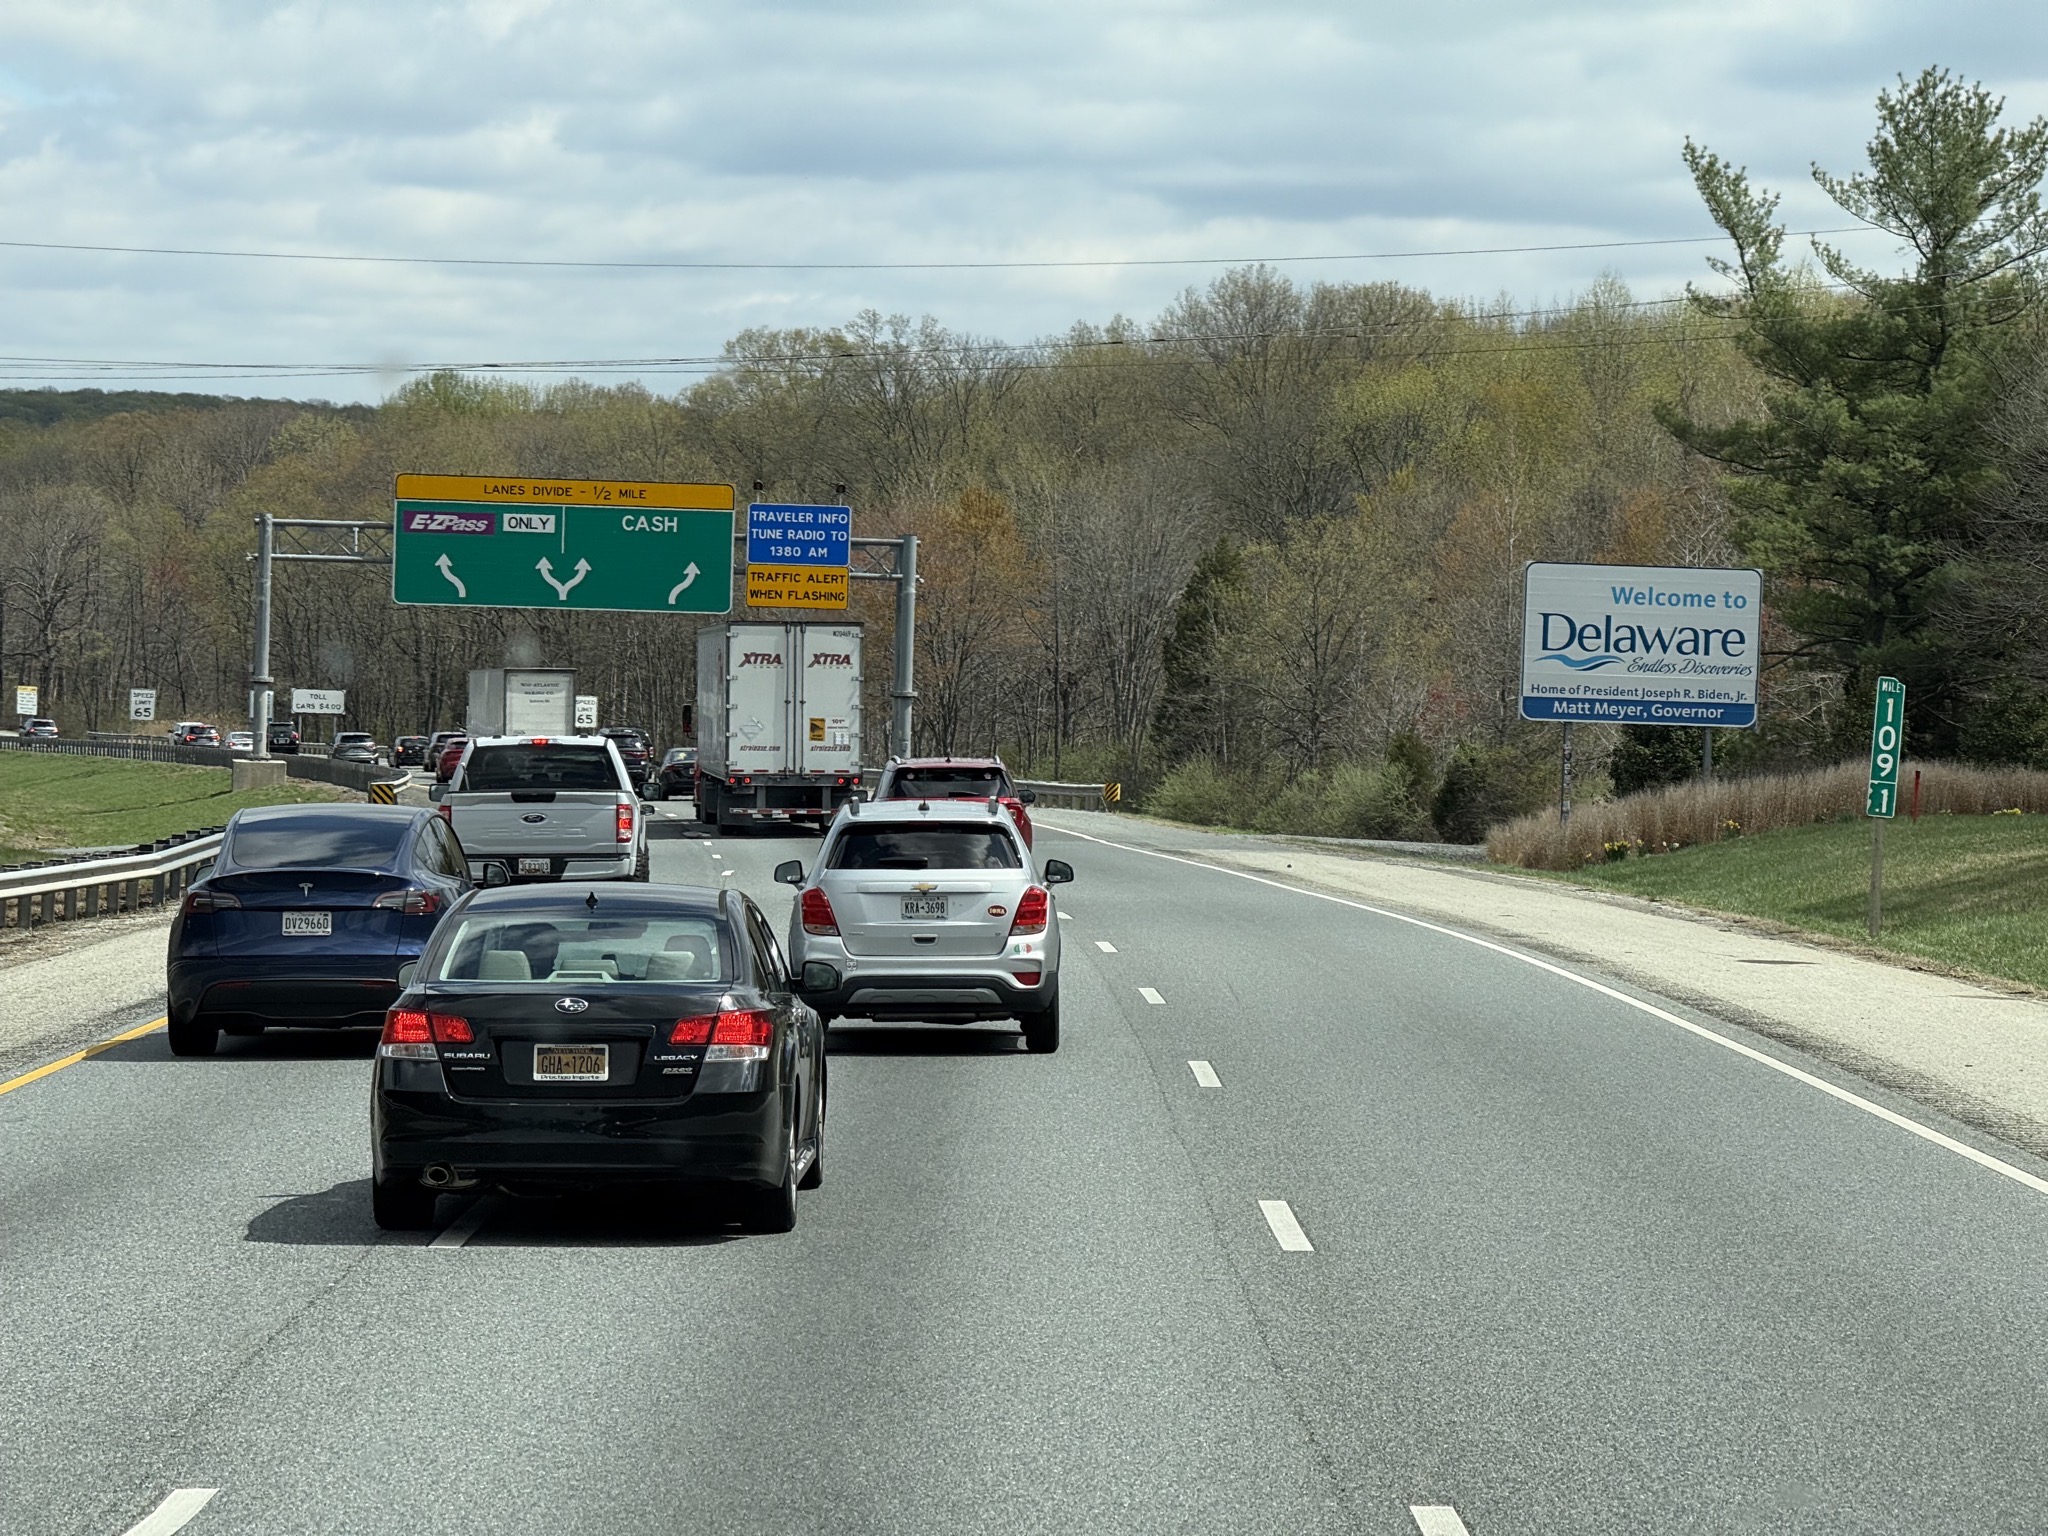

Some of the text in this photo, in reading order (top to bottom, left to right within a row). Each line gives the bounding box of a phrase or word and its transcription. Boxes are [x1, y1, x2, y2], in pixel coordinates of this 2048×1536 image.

[483, 484, 525, 495] LANES
[532, 486, 573, 497] DIVIDE
[618, 489, 647, 500] MILE
[508, 516, 550, 530] ONLY
[621, 515, 678, 533] CASH
[751, 511, 848, 524] TRAVELER INFO
[751, 528, 847, 541] TUNE RADIO TO
[769, 546, 828, 558] 1380 AM
[750, 571, 846, 584] TRAFFIC ALERT
[749, 589, 845, 602] WHEN FLASHING
[1611, 586, 1747, 609] Welcome to
[1538, 612, 1746, 657] Delaware
[738, 652, 782, 667] XTRA
[807, 653, 852, 668] XTRA
[1627, 656, 1753, 677] Endless Discoveries
[1531, 683, 1748, 703] Home of President Joseph R. Biden, Jr.
[1882, 681, 1901, 693] MILE
[134, 708, 152, 717] 65
[1552, 700, 1724, 719] Matt Meyer, Governor
[577, 715, 593, 724] 65
[905, 901, 945, 914] KRA 3698
[285, 917, 329, 930] DV29660
[443, 1052, 491, 1060] SUBARU
[541, 1056, 600, 1073] GHA 1206
